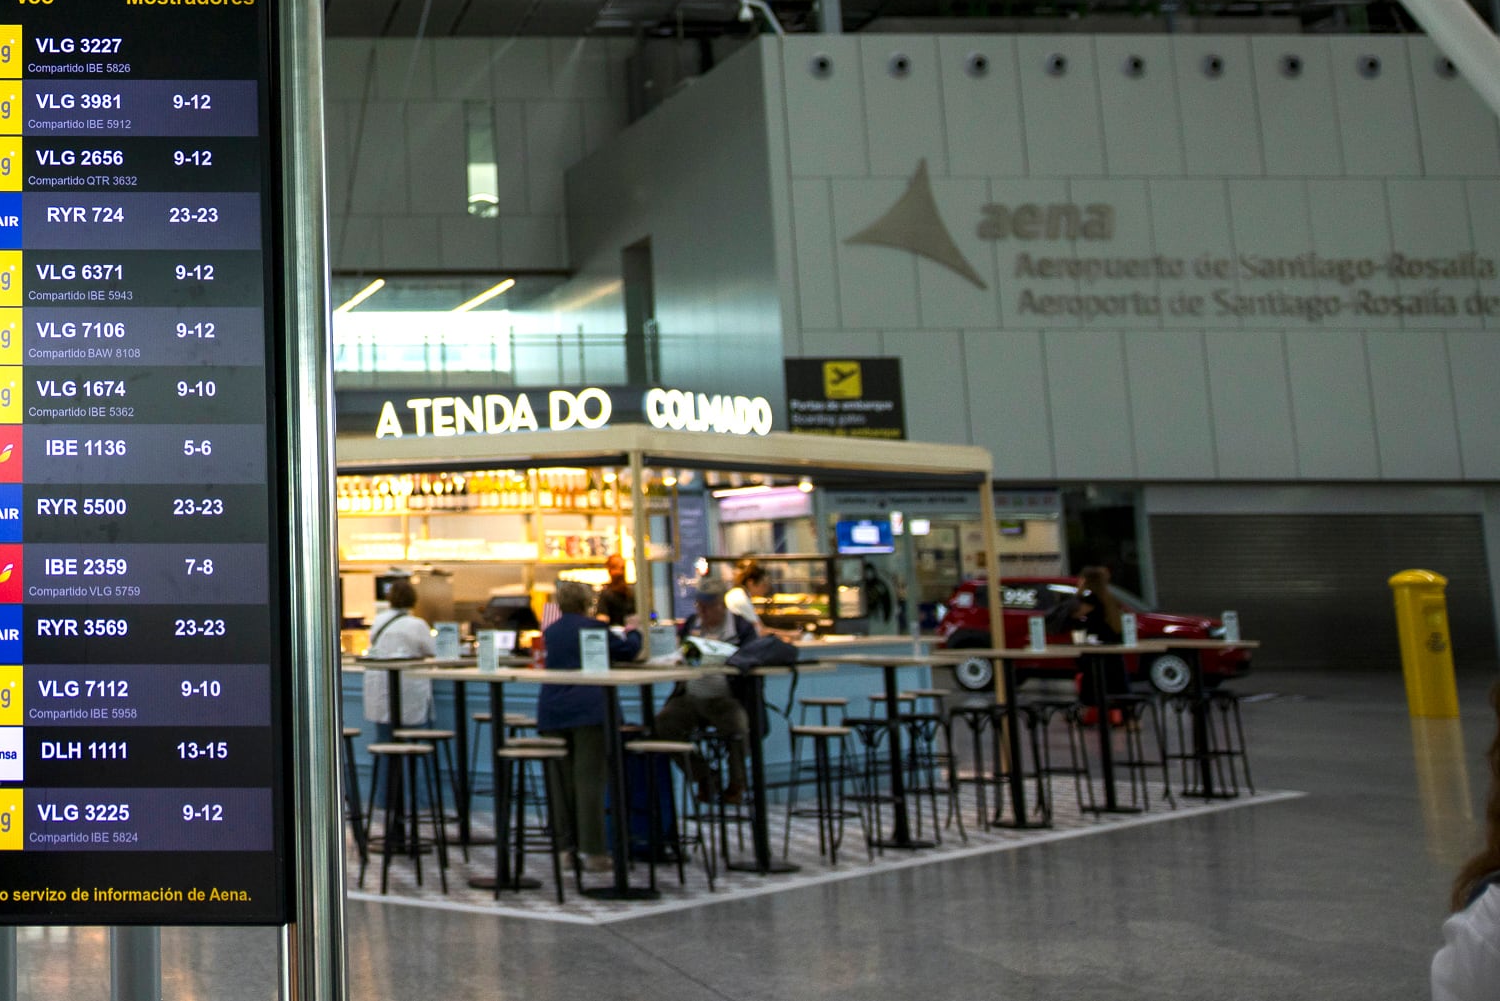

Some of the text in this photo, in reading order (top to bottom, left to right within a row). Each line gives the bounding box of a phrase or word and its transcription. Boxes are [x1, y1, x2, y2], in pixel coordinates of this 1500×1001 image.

[35, 37, 122, 54] VLG 3227
[27, 63, 131, 75] Compartido IBE 5826
[35, 93, 121, 109] VLG 3981
[172, 94, 211, 110] 9-12
[35, 150, 124, 166] VLG 2656
[173, 150, 212, 166] 9-12
[27, 175, 138, 188] Compartido QTR 3632
[47, 206, 125, 223] RYR 724
[169, 207, 219, 223] 23-23
[976, 203, 1115, 241] aena
[35, 264, 122, 280] VLG 6371
[175, 264, 214, 281] 9-12
[36, 322, 125, 338] VLG 7106
[176, 322, 215, 338] 9-12
[27, 348, 141, 361] Compartido BAW 8108
[36, 380, 126, 397] VLG 1674
[177, 380, 216, 397] 9-10
[375, 387, 612, 439] A TENDA DO
[645, 388, 773, 436] COLMADO
[46, 439, 126, 456] IBE 1136
[183, 439, 212, 456] 5-6
[37, 498, 127, 515] RYR 5500
[173, 498, 224, 515] 23-23
[45, 558, 127, 575] IBE 2359
[185, 558, 214, 575] 7-8
[28, 585, 141, 599] Compartido VLG 5759
[37, 619, 128, 636] RYR 3569
[174, 619, 226, 636] 23-23
[38, 680, 129, 697] VLG 7112
[181, 680, 221, 697] 9-10
[41, 741, 127, 759] DLH 1111
[177, 742, 228, 759] 13-15
[37, 804, 130, 821] VLG 3225
[182, 804, 223, 821] 9-12
[12, 887, 67, 902] servizo
[71, 887, 90, 902] de
[93, 887, 183, 902] información
[187, 887, 206, 902] de
[209, 887, 252, 902] Aena.
